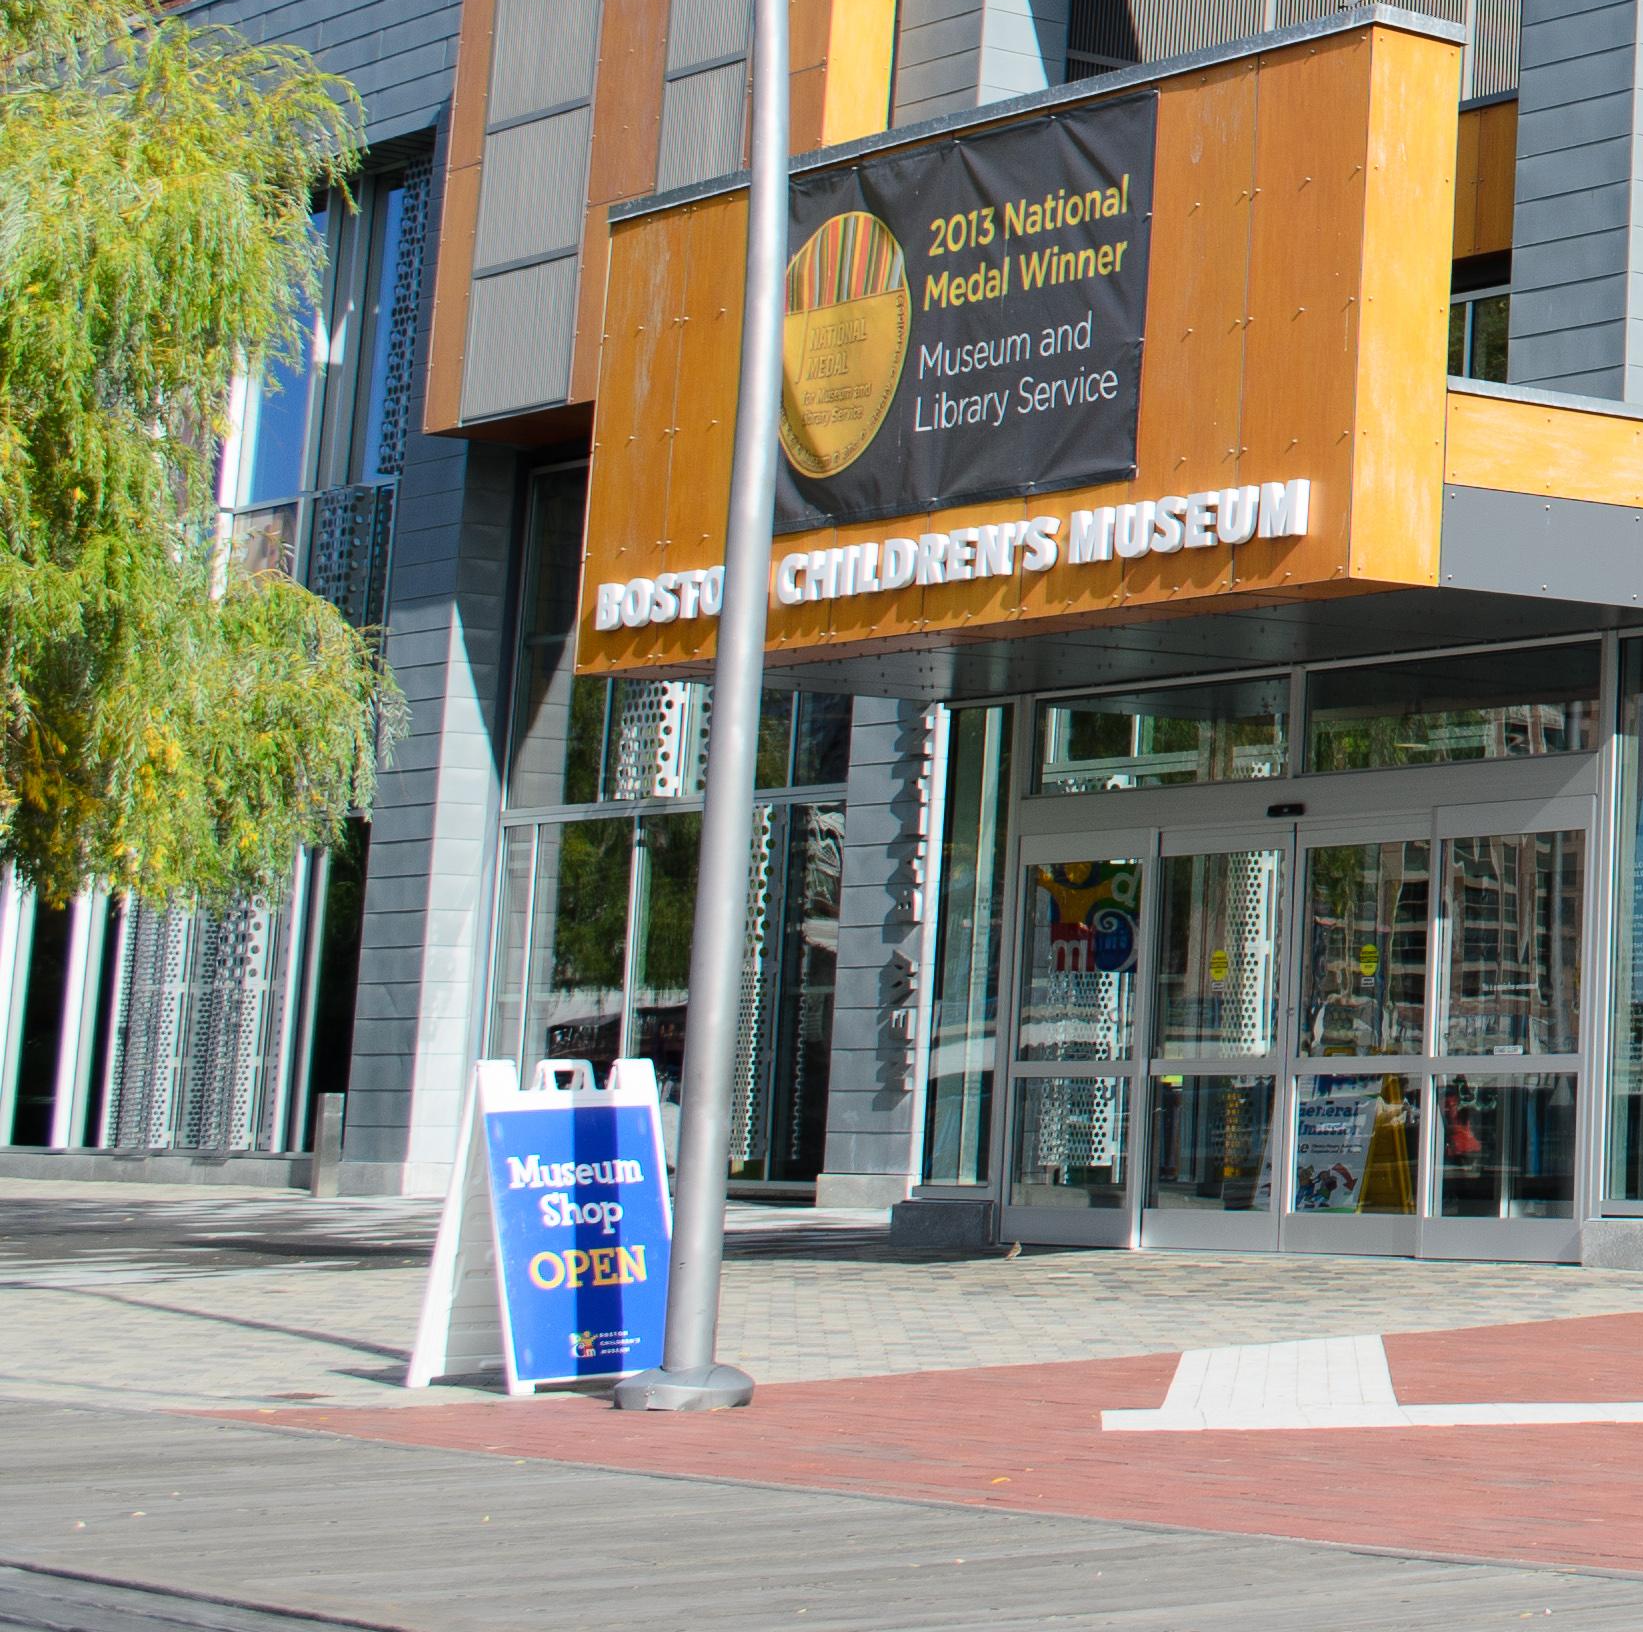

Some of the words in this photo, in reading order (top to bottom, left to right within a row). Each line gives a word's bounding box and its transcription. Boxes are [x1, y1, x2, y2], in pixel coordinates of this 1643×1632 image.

[928, 206, 996, 257] 2013
[1004, 173, 1130, 240] National
[923, 256, 1011, 312] Medal
[1019, 240, 1128, 291] Winner
[810, 318, 868, 352] NATIONAL
[919, 332, 1032, 380] Museum
[1039, 310, 1093, 357] and
[806, 351, 849, 381] MEDAL
[914, 389, 1010, 433] Library
[1017, 366, 1119, 414] Service
[596, 565, 725, 632] BOSTO
[776, 516, 1061, 605] CHILDREN'S
[1068, 478, 1311, 566] MUSEUM
[506, 1154, 645, 1189] Museum
[540, 1191, 624, 1235] Shop
[529, 1245, 648, 1290] OPEN
